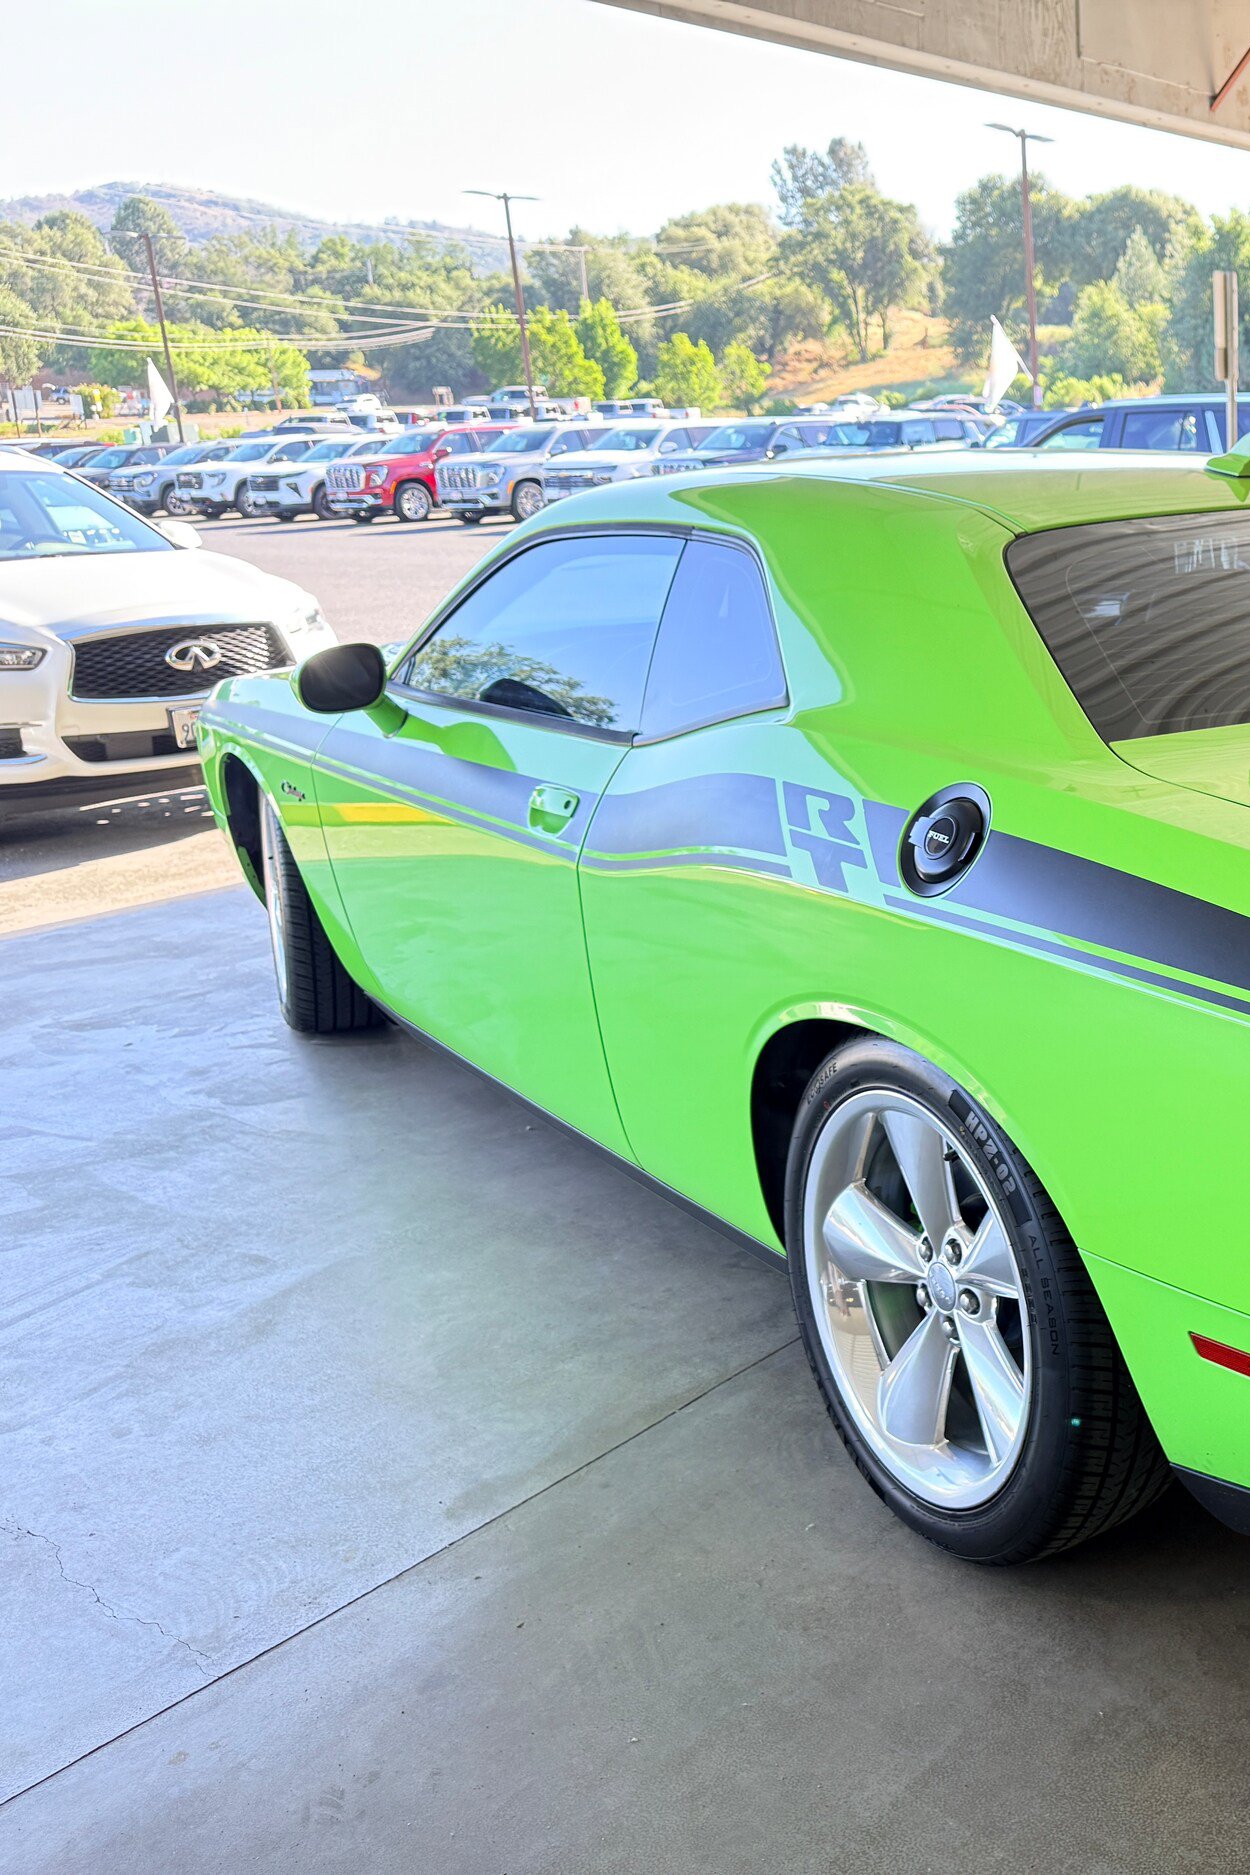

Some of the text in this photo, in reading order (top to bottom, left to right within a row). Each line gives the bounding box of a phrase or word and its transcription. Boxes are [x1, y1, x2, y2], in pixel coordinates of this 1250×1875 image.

[928, 829, 950, 845] FUEL
[1026, 1233, 1041, 1271] ALL
[1038, 1277, 1061, 1357] SEASON
